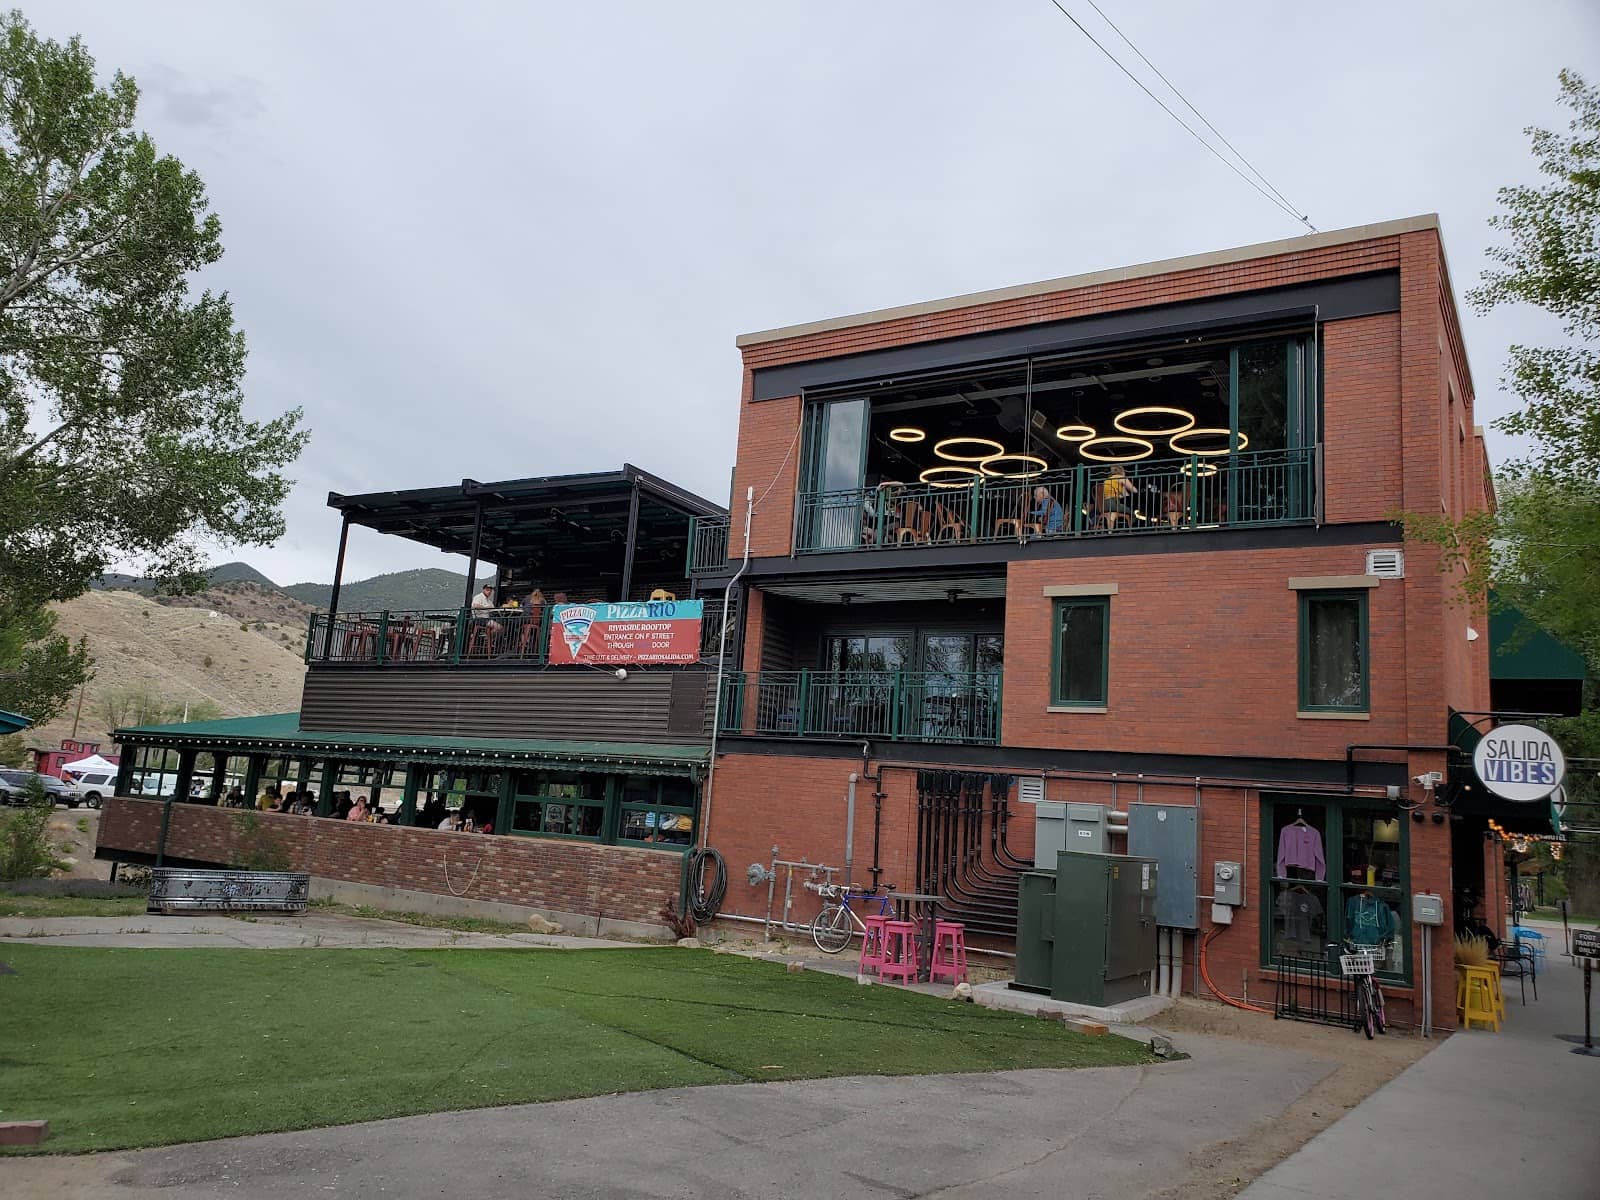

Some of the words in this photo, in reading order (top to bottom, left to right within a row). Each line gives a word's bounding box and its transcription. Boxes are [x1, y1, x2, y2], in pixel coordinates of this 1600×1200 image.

[607, 602, 675, 618] PIZZARIO
[641, 623, 672, 631] ROOFTOP
[651, 632, 675, 640] STREET
[652, 641, 670, 649] DOOR
[1486, 739, 1552, 761] SALIDA
[1485, 760, 1554, 783] VIBES
